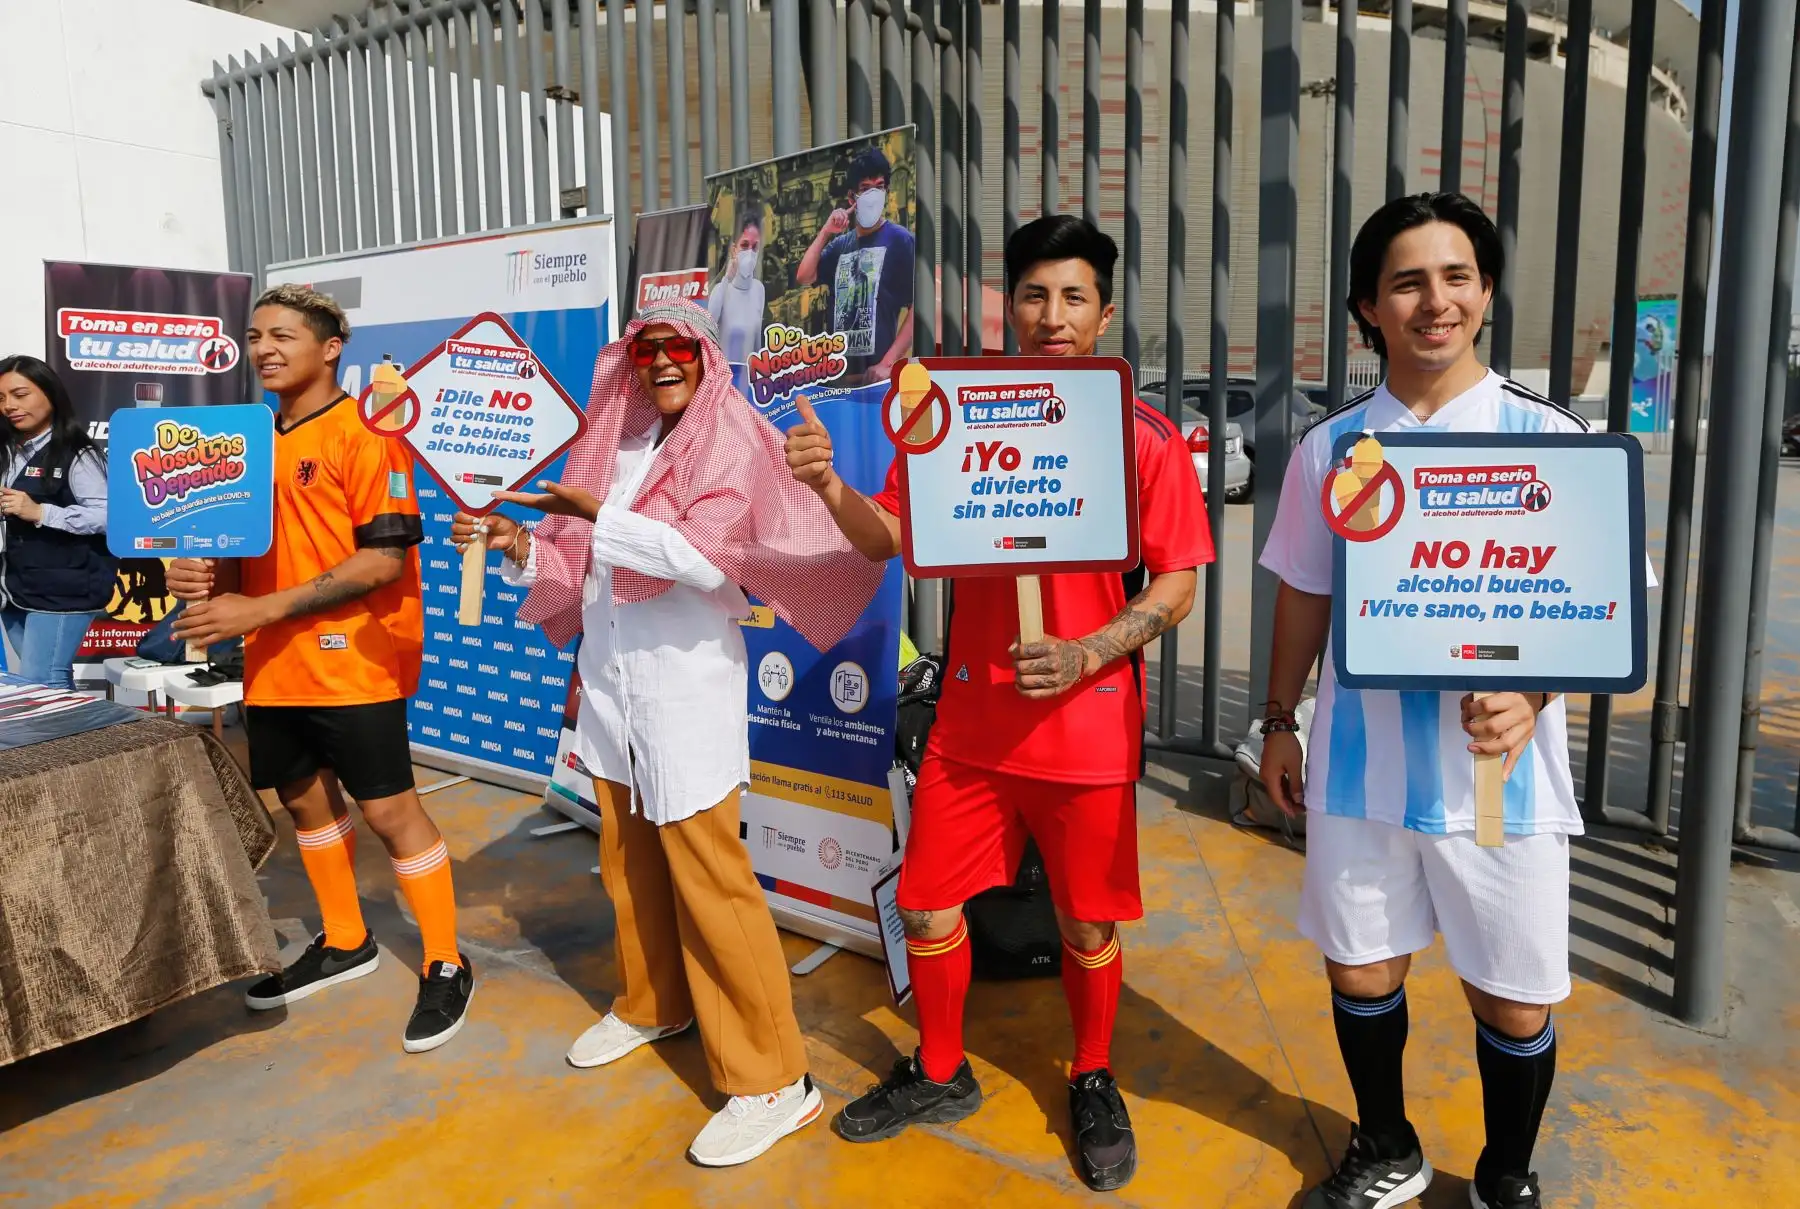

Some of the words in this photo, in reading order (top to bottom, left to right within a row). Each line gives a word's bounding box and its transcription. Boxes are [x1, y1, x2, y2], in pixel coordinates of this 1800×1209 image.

[534, 254, 586, 271] Siempre
[552, 269, 586, 287] pueblo
[644, 284, 680, 301] Toma
[683, 282, 699, 296] en
[67, 315, 127, 333] Toma
[132, 321, 158, 334] en
[162, 322, 215, 338] serio
[768, 326, 801, 352] De
[79, 337, 112, 357] tu
[116, 340, 197, 360] salud
[451, 344, 481, 354] Toma
[499, 350, 526, 359] serio
[456, 356, 472, 367] tu
[474, 359, 517, 372] salud
[749, 335, 845, 382] Nosotros
[85, 361, 121, 369] alcohol
[123, 362, 177, 372] adulterado
[179, 365, 204, 373] mata
[754, 356, 845, 404] Depende
[436, 389, 483, 406] ¡Dile
[489, 390, 532, 411] NO
[786, 401, 796, 410] gua
[824, 388, 851, 397] COVID-19
[962, 390, 997, 401] Toma
[1000, 390, 1015, 399] en
[1018, 386, 1050, 398] serio
[431, 406, 448, 417] al
[452, 409, 534, 426] consumo
[970, 406, 988, 420] tu
[991, 401, 1040, 420] salud
[158, 423, 198, 450] De
[432, 422, 454, 435] de
[459, 425, 531, 443] bebidas
[426, 439, 535, 460] alcohólicas!
[135, 436, 244, 482] Nosotros
[962, 441, 1021, 472] ¡Yo
[1033, 454, 1068, 470] me
[143, 458, 244, 505] Depende
[1419, 472, 1463, 484] Toma
[1467, 472, 1486, 483] en
[1491, 468, 1532, 482] serio
[971, 476, 1061, 495] divierto
[419, 489, 437, 498] MINSA
[1427, 489, 1451, 505] tu
[1455, 487, 1519, 505] salud
[151, 515, 161, 523] No
[161, 508, 175, 519] bajar
[204, 496, 217, 504] ante
[223, 491, 251, 500] COVID-19
[953, 501, 986, 519] sin
[992, 498, 1083, 518] alcohol!
[1431, 509, 1459, 517] alcohol
[434, 513, 452, 522] MINSA
[1410, 540, 1470, 568] NO
[1480, 540, 1556, 574] hay
[431, 560, 449, 569] MINSA
[439, 584, 457, 594] MINSA
[1397, 575, 1483, 593] alcohol
[1487, 575, 1572, 594] bueno.
[497, 592, 517, 602] MINSA
[426, 606, 444, 616] MINSA
[1359, 600, 1419, 617] ¡Vive
[1424, 602, 1486, 621] sano,
[1493, 603, 1524, 619] no
[1530, 601, 1617, 620] bebas!
[484, 615, 503, 625] MINSA
[102, 629, 149, 637] informac
[434, 632, 452, 642] MINSA
[83, 639, 91, 647] al
[462, 636, 482, 647] MINSA
[493, 641, 513, 652] MINSA
[525, 646, 546, 658] MINSA
[558, 651, 575, 662] MINS
[449, 658, 468, 670] MINSA
[478, 664, 498, 675] MINSA
[511, 670, 531, 682] MINSA
[542, 675, 564, 687] MINSA
[428, 678, 447, 690] MINSA
[457, 684, 476, 696] MINSA
[488, 690, 508, 703] MINSA
[520, 697, 540, 709] MINSA
[415, 700, 433, 712] MINSA
[443, 706, 462, 718] MINSA
[551, 703, 565, 713] MIN
[757, 704, 781, 715] Mantén
[784, 708, 790, 718] la
[472, 712, 492, 724] MINSA
[809, 713, 832, 725] Ventila
[833, 719, 843, 727] los
[845, 720, 885, 735] ambientes
[422, 725, 440, 738] MINSA
[504, 720, 525, 732] MINSA
[781, 720, 800, 731] física
[450, 732, 469, 745] MINSA
[537, 727, 558, 739] MINSA
[816, 728, 821, 736] y
[823, 727, 839, 738] abre
[841, 732, 877, 745] ventanas
[481, 740, 501, 752] MINSA
[513, 747, 534, 760] MINSA
[772, 776, 791, 788] llama
[793, 781, 813, 792] gratis
[832, 790, 844, 800] 113
[847, 793, 873, 806] SALUD
[778, 831, 806, 845] Siempre
[787, 843, 805, 853] pueblo
[1032, 955, 1051, 964] ATK
